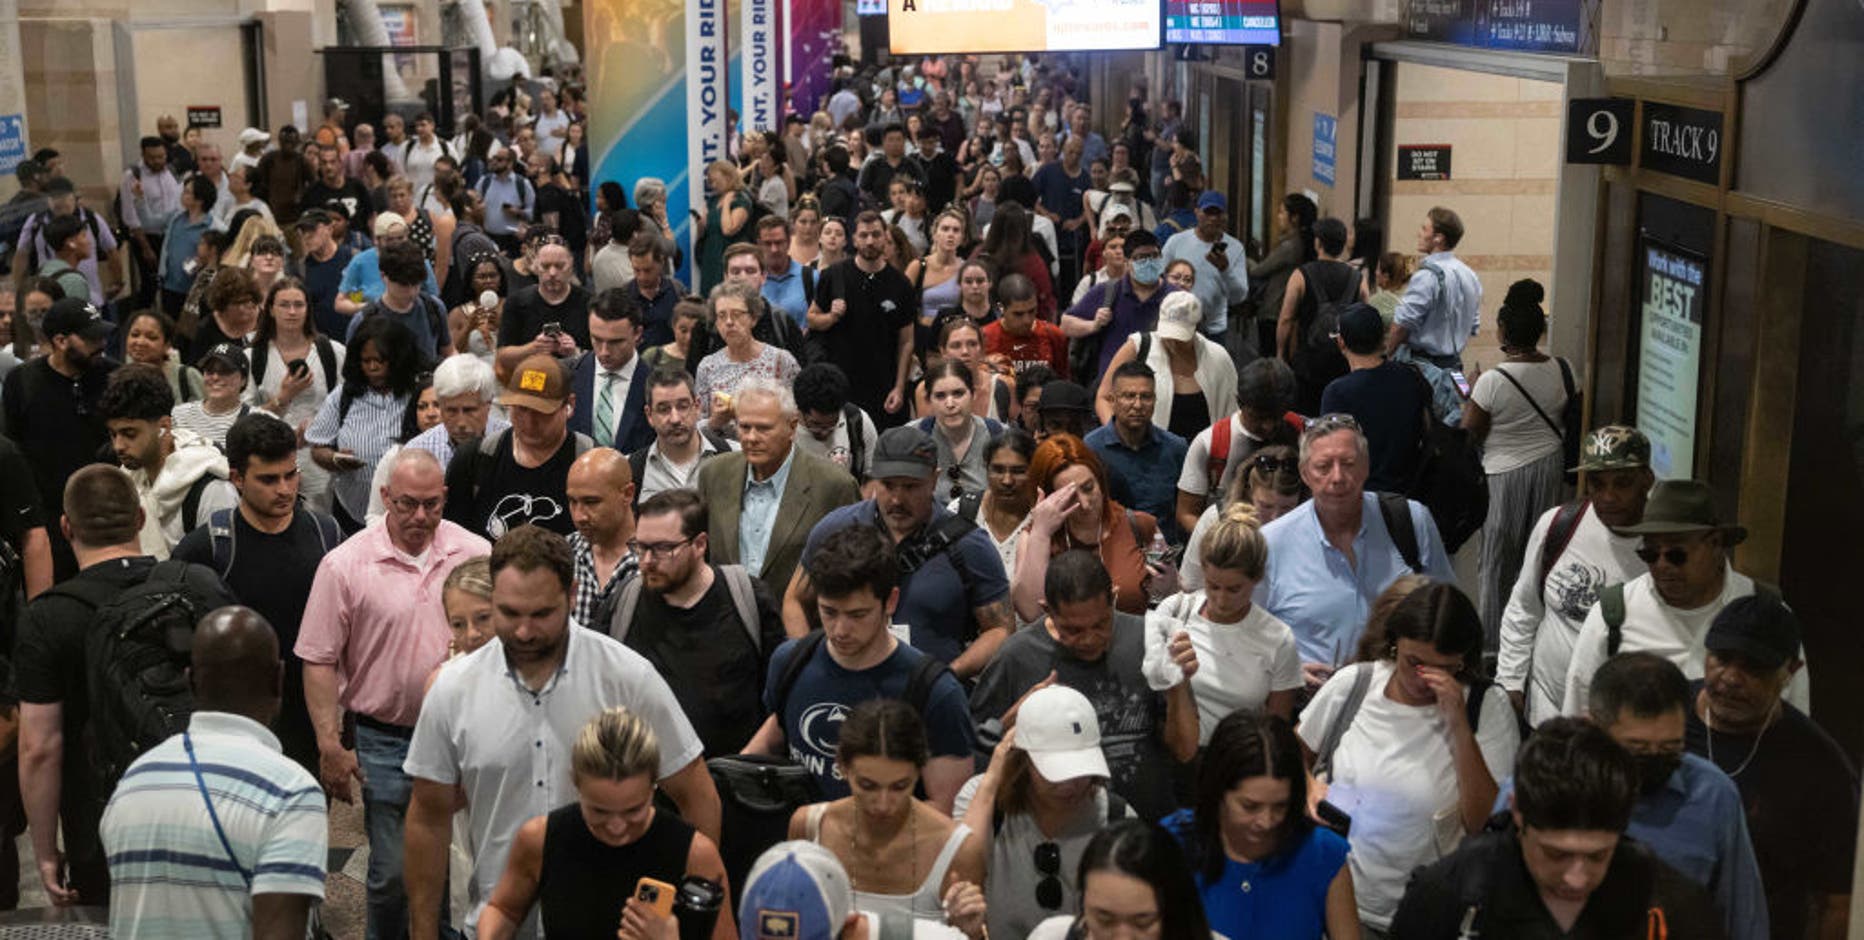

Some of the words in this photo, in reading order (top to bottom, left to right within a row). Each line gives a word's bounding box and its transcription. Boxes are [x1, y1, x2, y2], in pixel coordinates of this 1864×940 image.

[753, 31, 767, 87] YOUR
[1252, 51, 1269, 76] 8
[701, 46, 717, 127] YOUR
[1586, 110, 1619, 154] 9
[1650, 119, 1704, 160] TRACK
[1706, 129, 1719, 164] 9
[1651, 273, 1696, 323] BEST
[1591, 431, 1612, 456] NY
